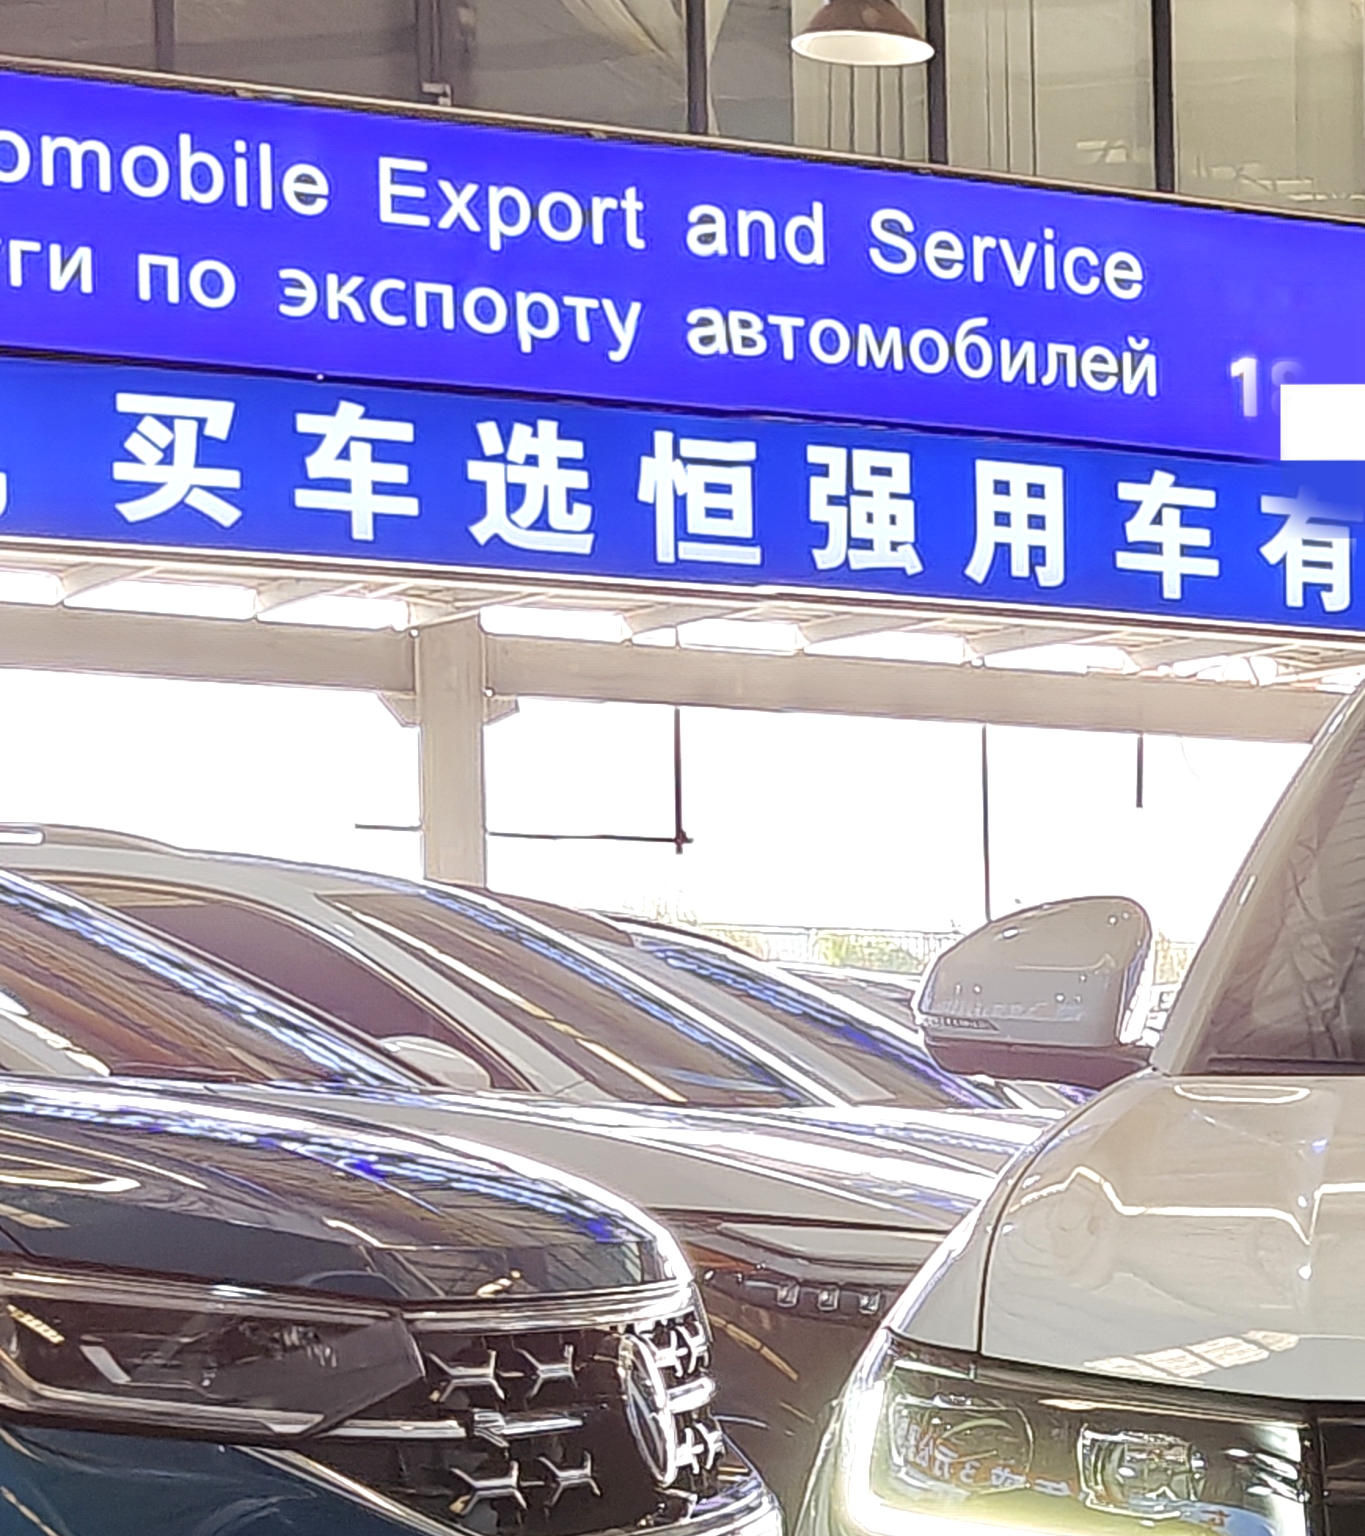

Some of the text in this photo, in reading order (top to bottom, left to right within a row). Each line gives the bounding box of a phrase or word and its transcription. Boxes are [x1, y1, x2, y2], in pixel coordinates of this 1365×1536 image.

[378, 156, 646, 250] Export
[686, 200, 825, 265] and
[868, 208, 1144, 300] Service
[138, 253, 236, 309] по
[279, 268, 642, 362] экспорту
[686, 307, 1157, 397] автомобилей
